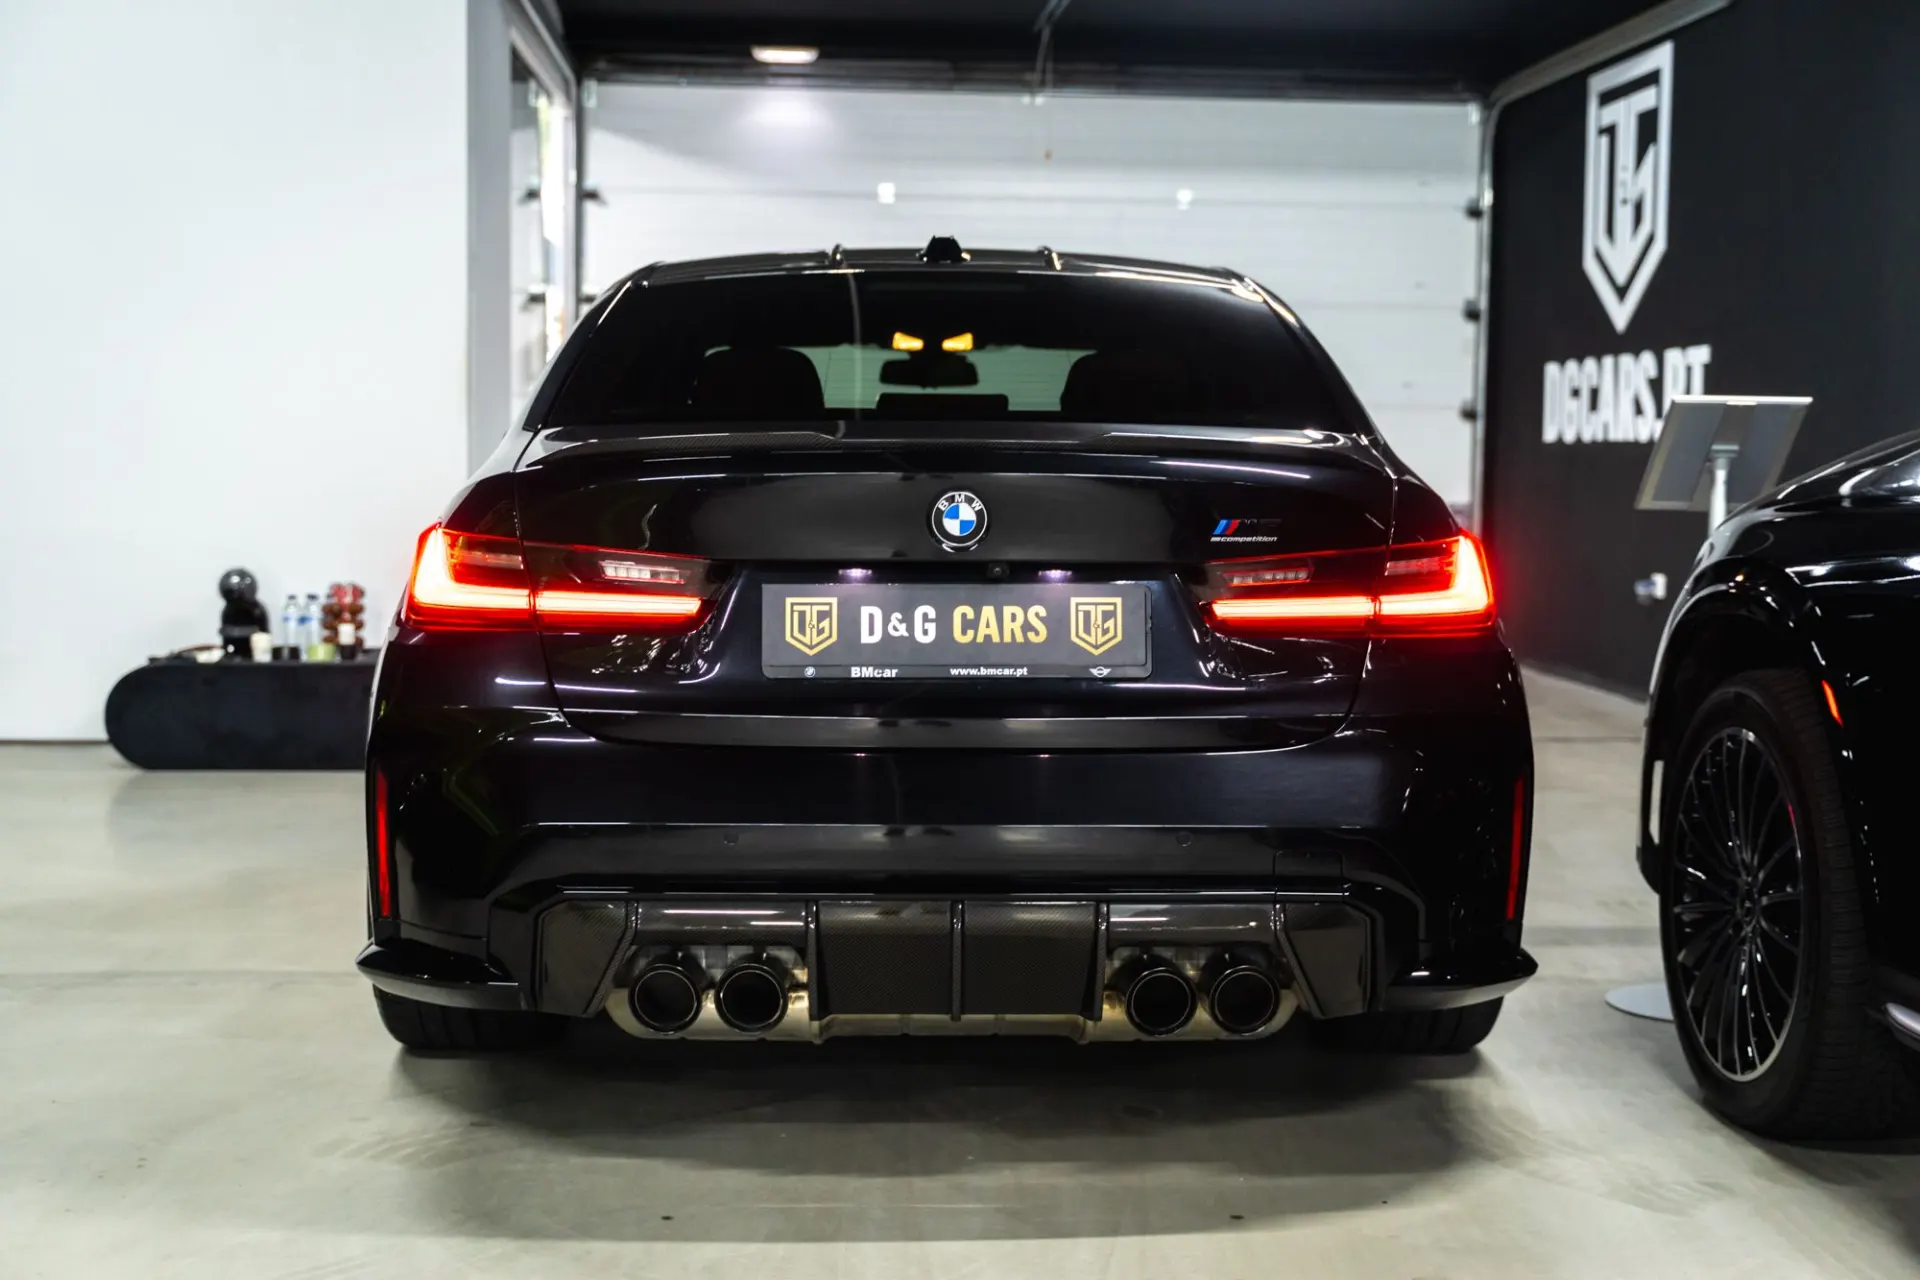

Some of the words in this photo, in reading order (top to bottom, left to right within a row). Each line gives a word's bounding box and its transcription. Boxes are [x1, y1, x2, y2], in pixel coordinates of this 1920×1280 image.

[938, 493, 983, 511] BMW
[860, 604, 937, 644] D&G
[952, 604, 1048, 644] CARS
[850, 666, 898, 678] BMcar
[949, 666, 1028, 678] www.bmcar.pt
